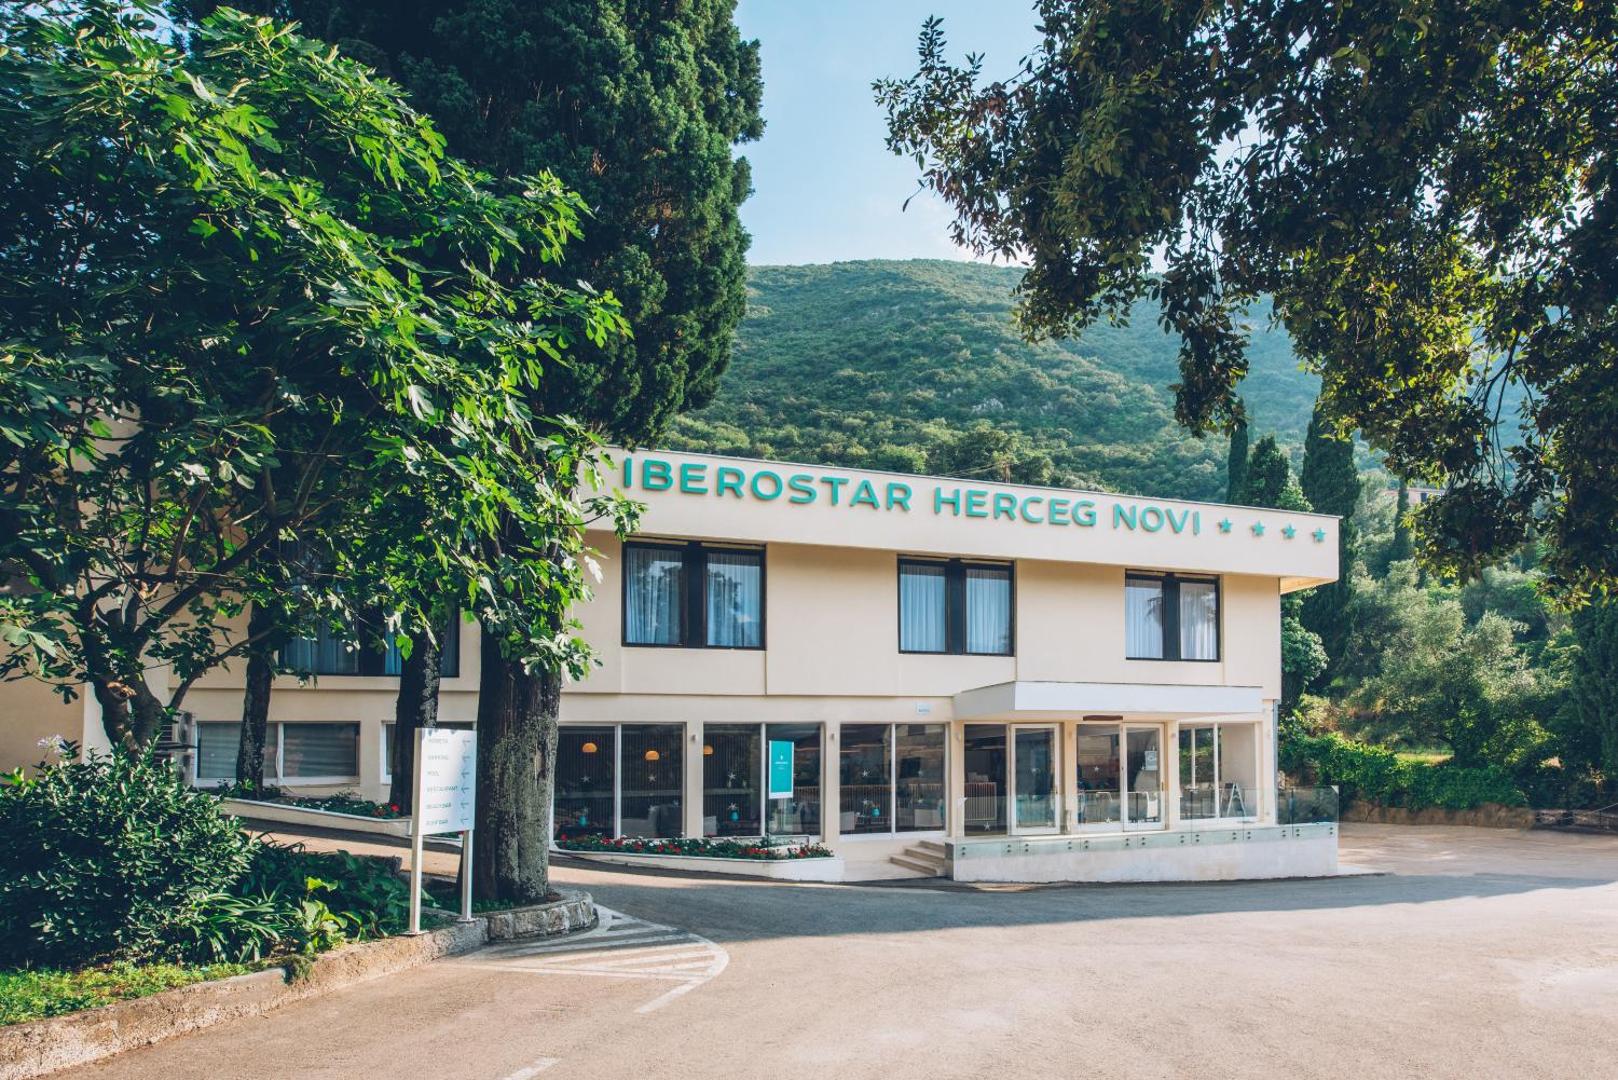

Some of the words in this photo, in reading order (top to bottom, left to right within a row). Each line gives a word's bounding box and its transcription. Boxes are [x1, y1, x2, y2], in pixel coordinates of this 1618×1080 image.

[623, 457, 913, 511] IBEROSTAR
[933, 486, 1097, 527] HERCEG
[1112, 502, 1200, 536] NOVI
